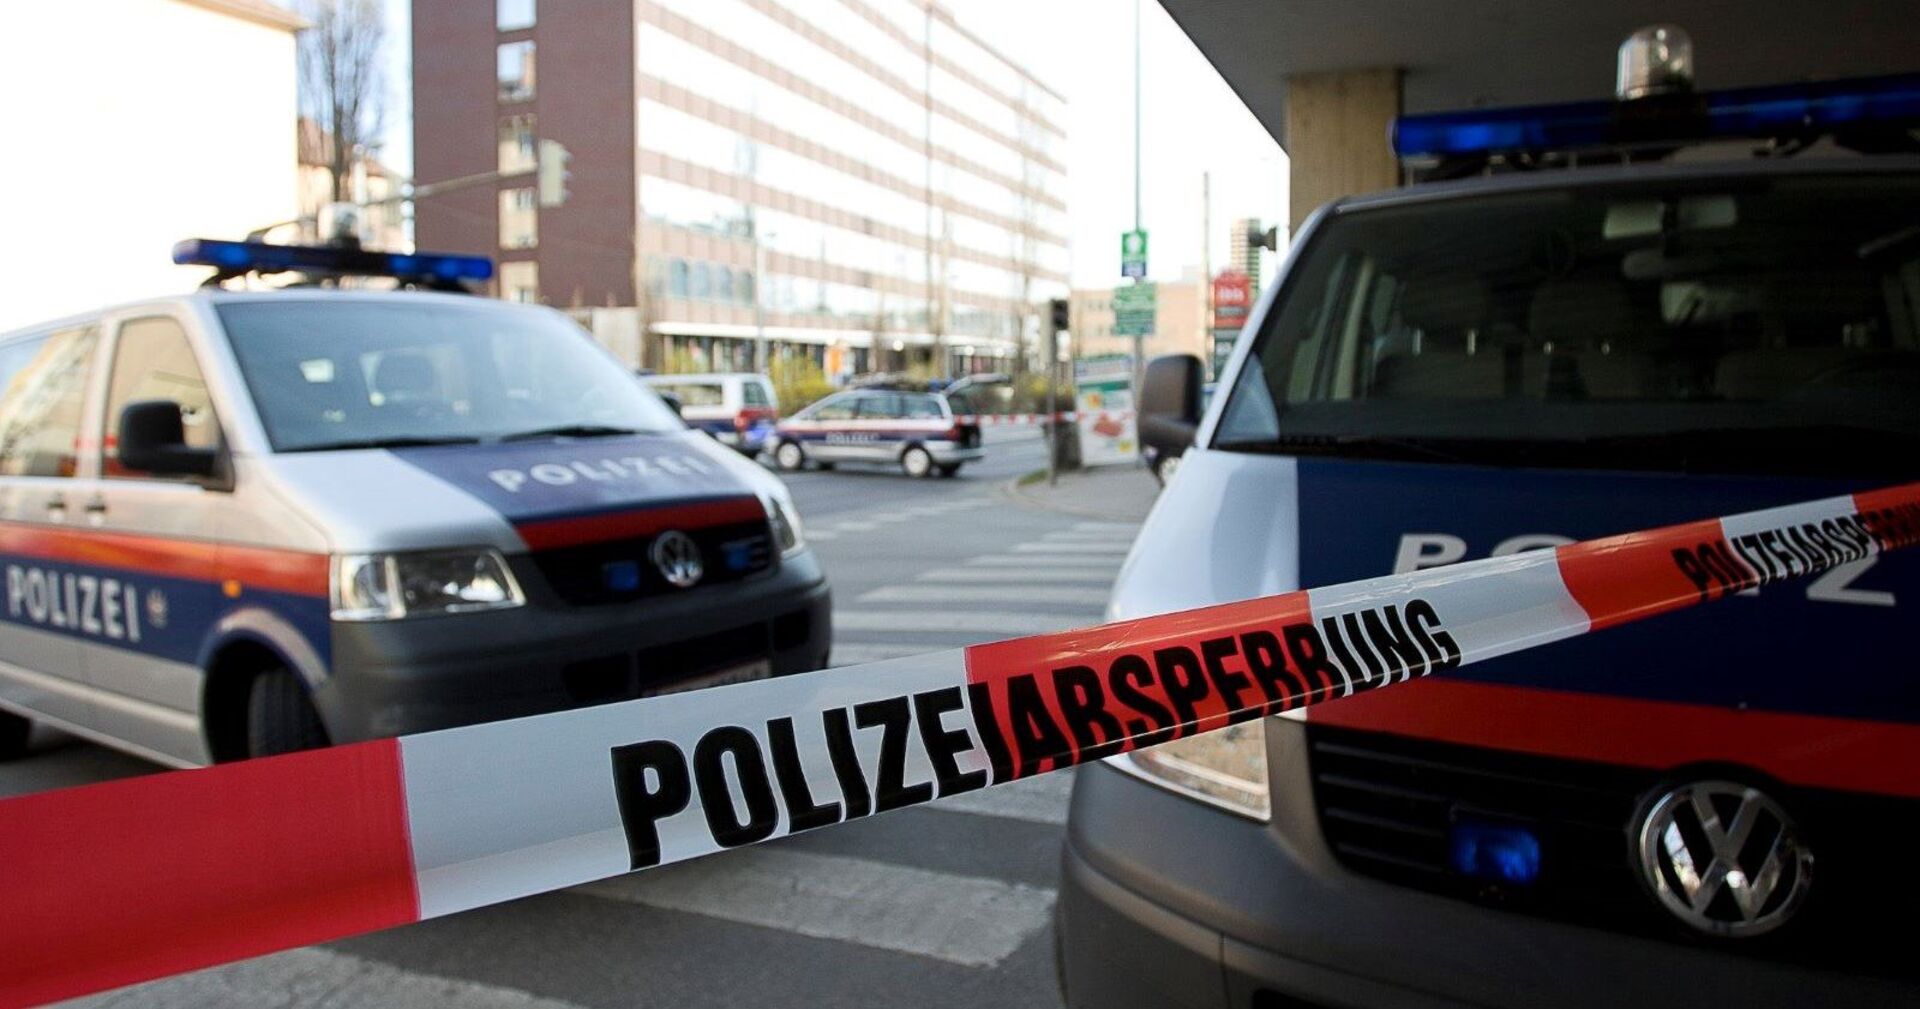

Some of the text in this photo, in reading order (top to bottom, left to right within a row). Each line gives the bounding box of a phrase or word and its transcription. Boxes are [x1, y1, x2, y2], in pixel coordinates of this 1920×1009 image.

[489, 456, 710, 493] POLIZEI
[6, 564, 141, 643] POLIZEI
[611, 598, 1461, 870] POLIZEIABSPERRUNG
